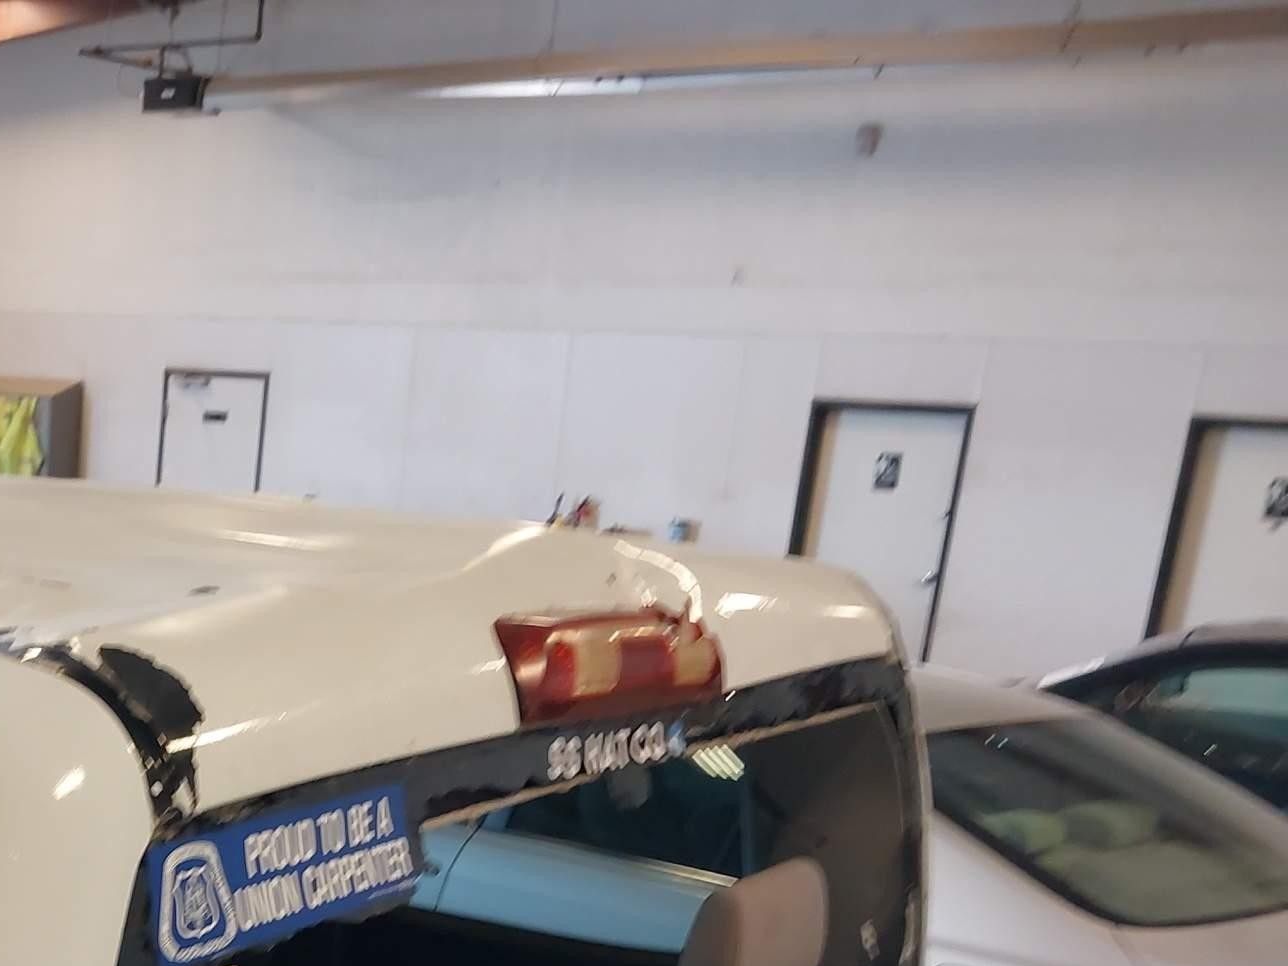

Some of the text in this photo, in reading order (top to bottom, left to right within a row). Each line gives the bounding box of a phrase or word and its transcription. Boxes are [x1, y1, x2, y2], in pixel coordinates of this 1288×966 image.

[244, 796, 394, 879] PROUD TO BE A
[234, 871, 304, 932] UNION
[302, 836, 414, 909] CARPENTER
